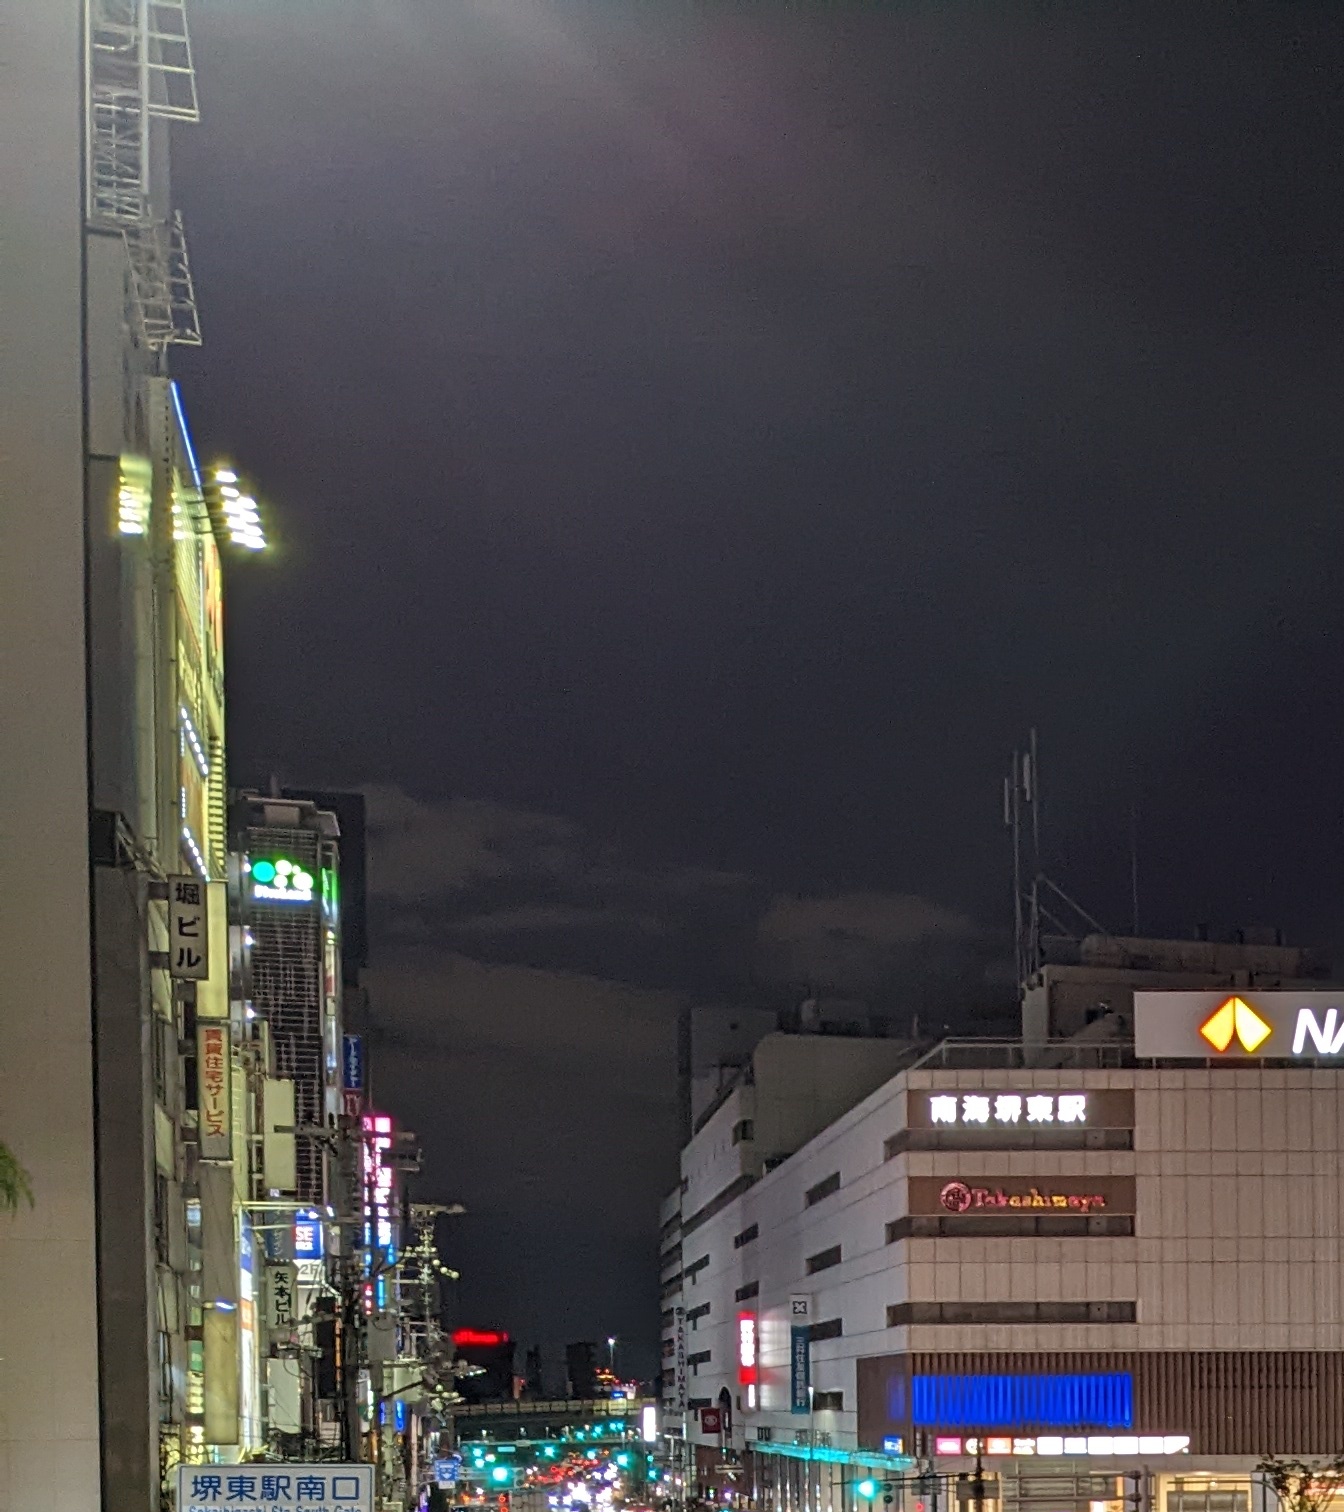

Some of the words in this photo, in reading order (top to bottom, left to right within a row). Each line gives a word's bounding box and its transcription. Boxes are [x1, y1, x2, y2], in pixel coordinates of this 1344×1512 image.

[175, 882, 201, 968] 堀ビル
[929, 1094, 1087, 1123] 南海堺東駅
[972, 1188, 1105, 1213] Takashimaya
[190, 1474, 360, 1502] 堺東駅南口
